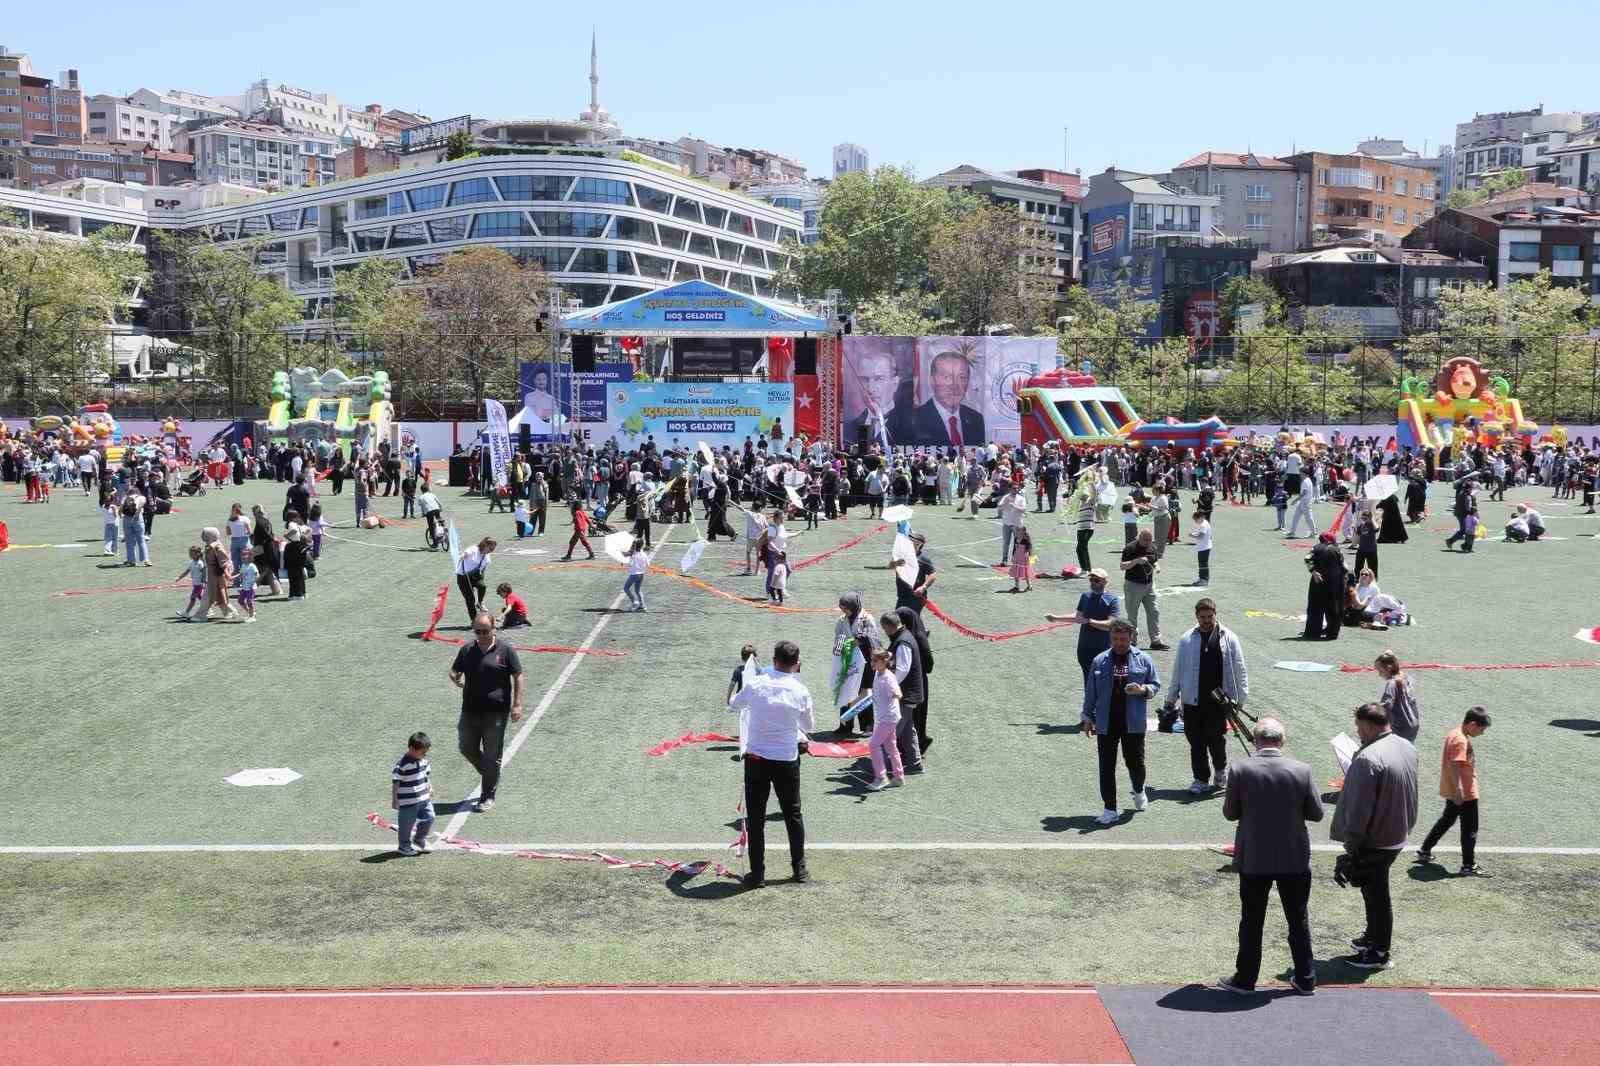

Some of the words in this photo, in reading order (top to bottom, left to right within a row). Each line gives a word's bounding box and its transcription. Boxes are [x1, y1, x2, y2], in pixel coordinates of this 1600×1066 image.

[666, 312, 683, 321] HOŞ
[685, 311, 724, 320] GELDİNİZ
[668, 422, 688, 433] HOŞ
[690, 420, 734, 432] GELDİNİZ
